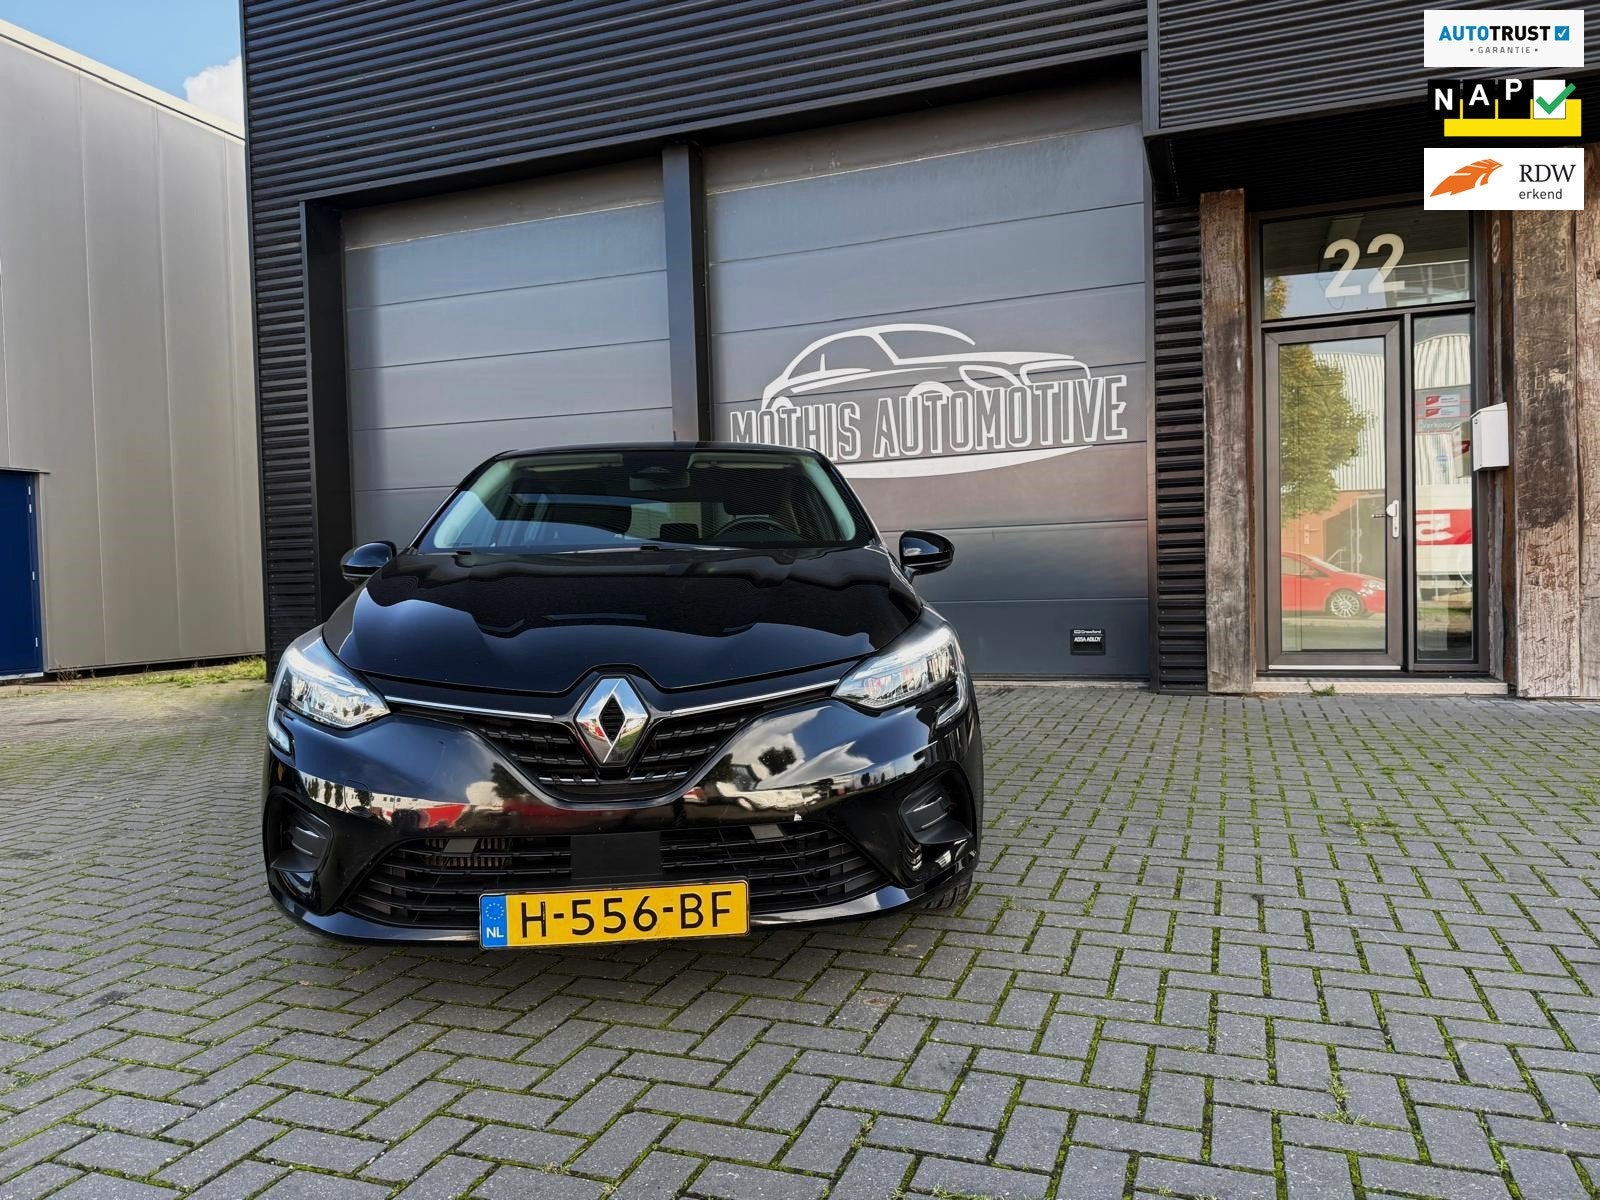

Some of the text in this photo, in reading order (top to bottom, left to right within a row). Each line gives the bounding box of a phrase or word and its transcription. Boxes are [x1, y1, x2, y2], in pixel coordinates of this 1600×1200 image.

[1324, 233, 1405, 298] 22
[730, 375, 1127, 461] MOTHIS AUTOMOTIVE
[486, 926, 504, 939] NL
[521, 891, 732, 938] H-556-BF
